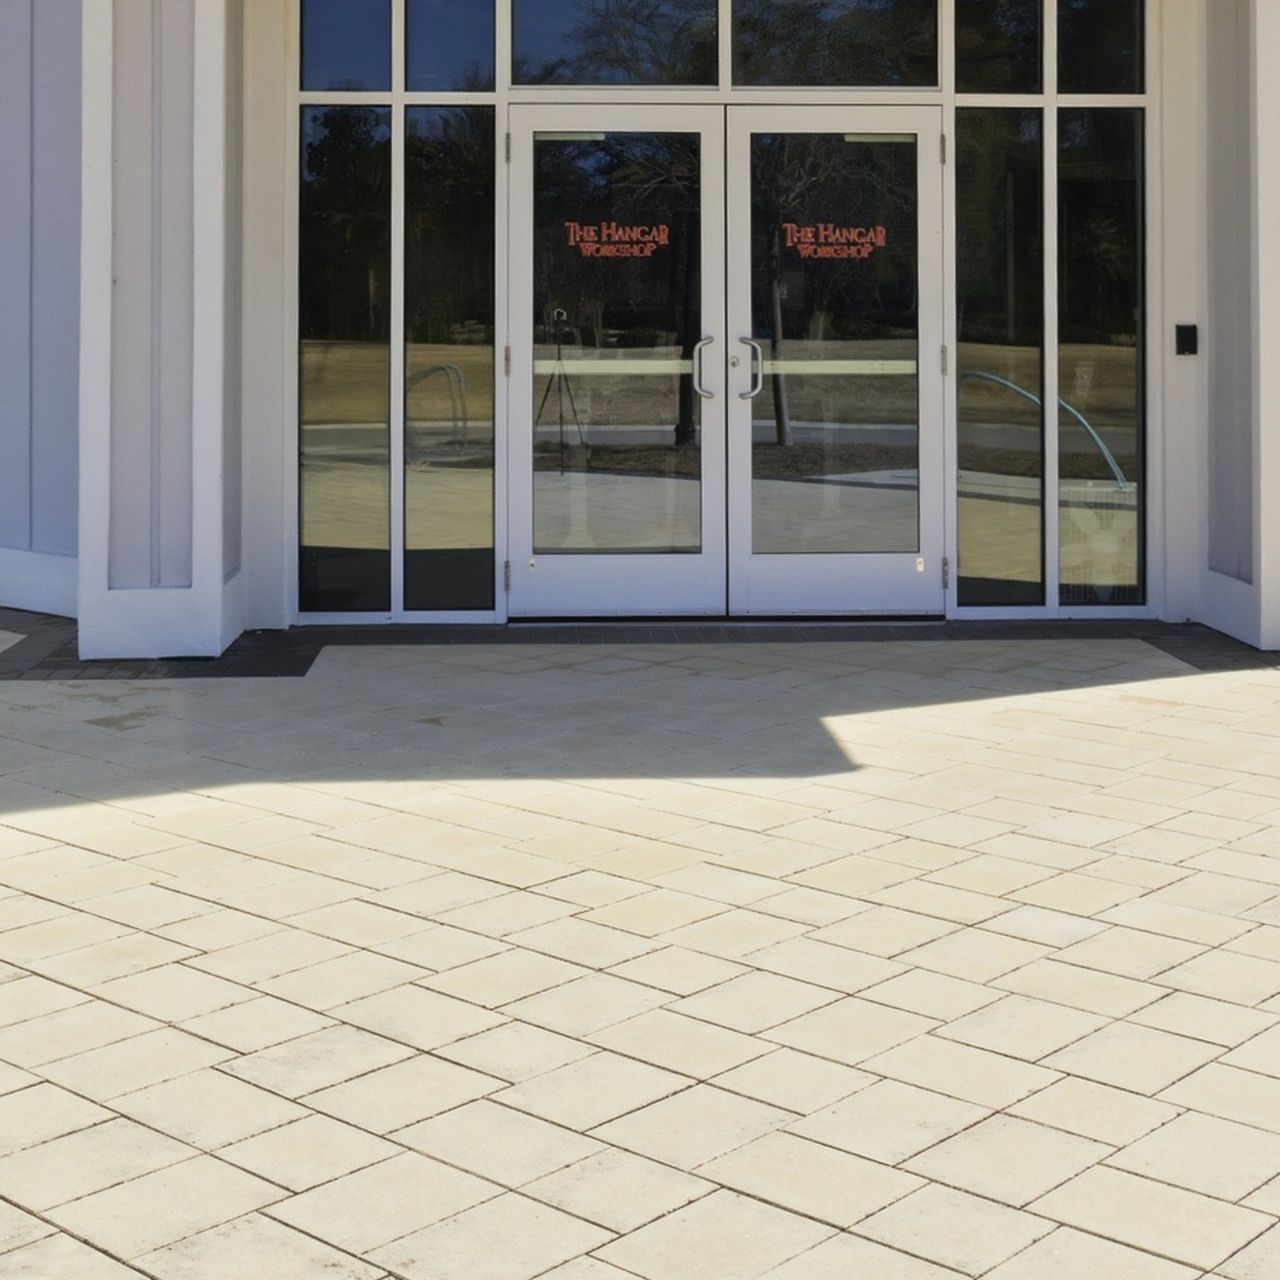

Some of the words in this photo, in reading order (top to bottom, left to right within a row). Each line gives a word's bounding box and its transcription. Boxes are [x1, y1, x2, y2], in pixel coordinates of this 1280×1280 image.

[565, 221, 598, 245] THE
[600, 221, 670, 245] HANGAR
[782, 222, 816, 247] THE
[818, 222, 887, 247] HANGAR
[577, 241, 657, 258] WORKSHOP
[795, 243, 874, 259] WORKSHOP
